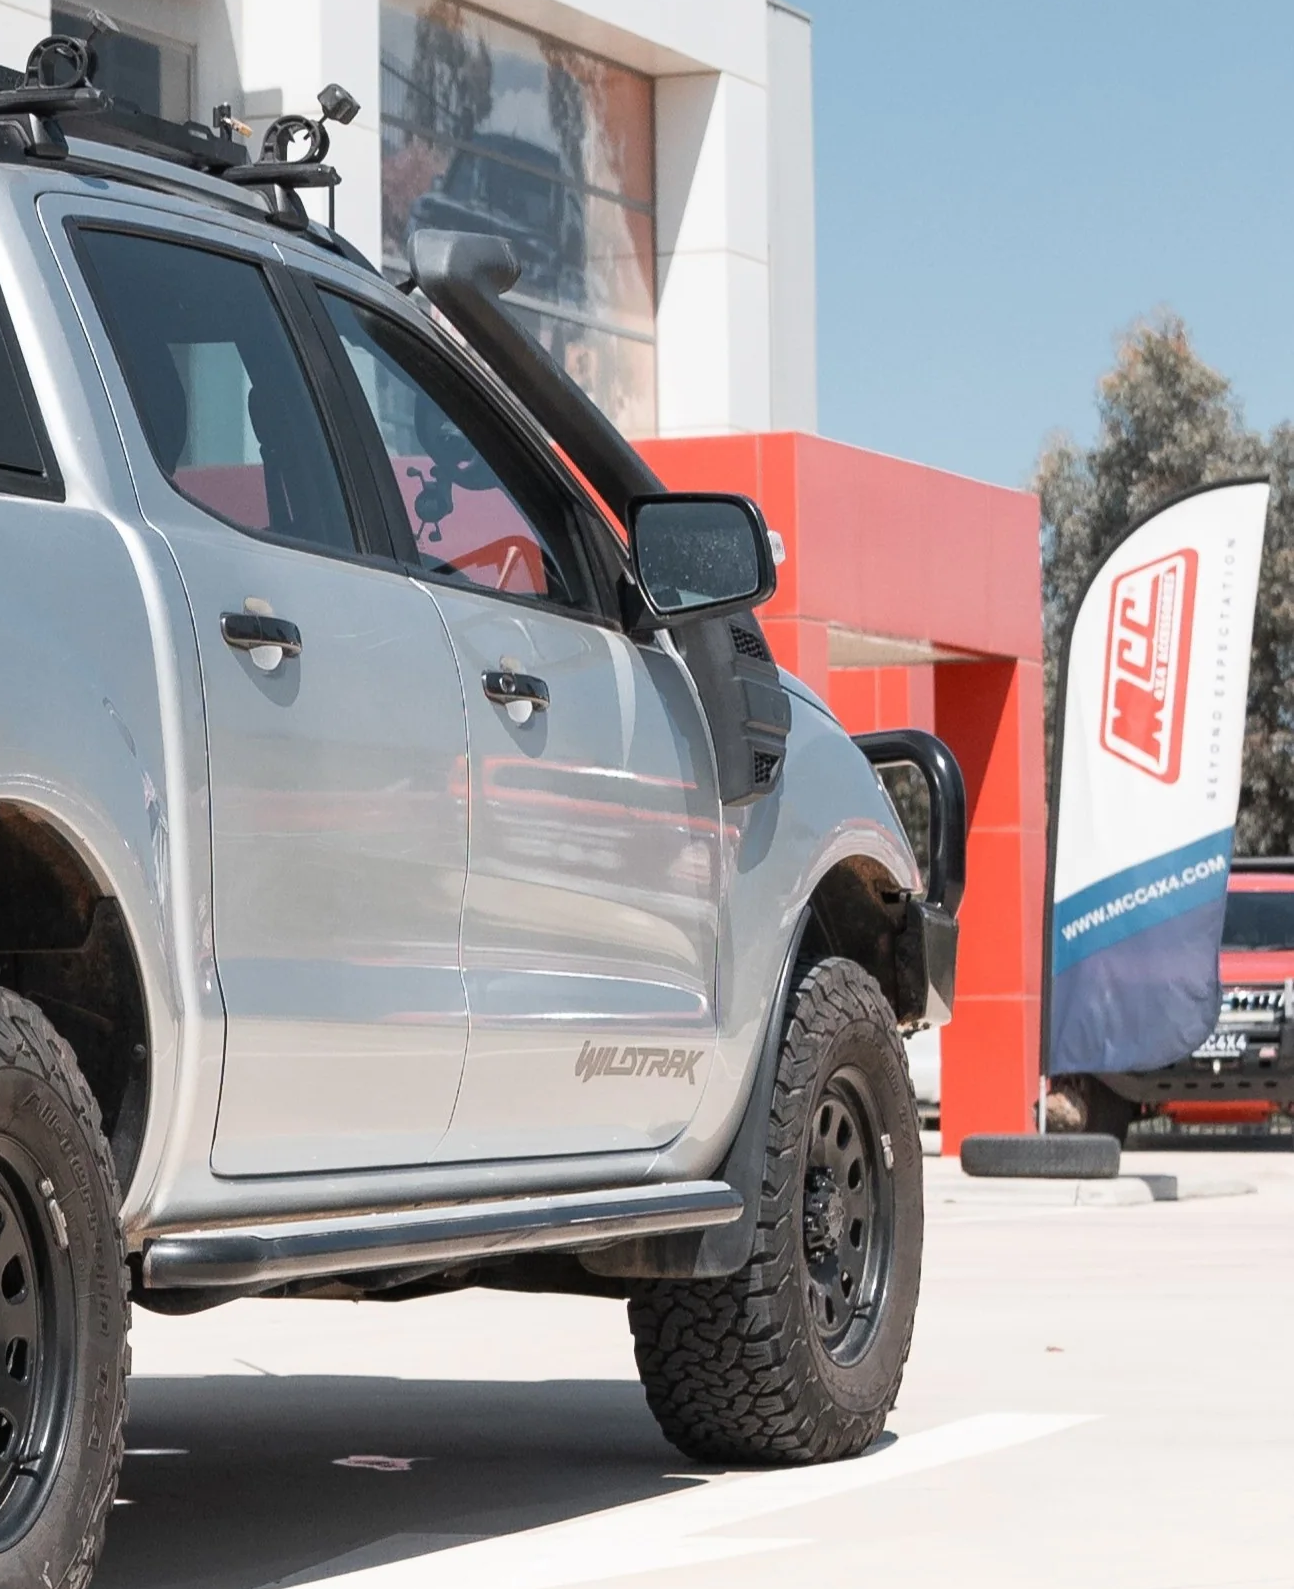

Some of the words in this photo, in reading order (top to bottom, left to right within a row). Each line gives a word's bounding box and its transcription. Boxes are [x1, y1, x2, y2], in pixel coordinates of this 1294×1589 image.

[1214, 538, 1236, 698] EXPECTATION
[1112, 573, 1164, 767] MCC
[1206, 710, 1223, 801] BEYOND
[1061, 853, 1226, 942] WWW.MCC4X4.COM
[574, 1039, 705, 1086] WILDTRAK
